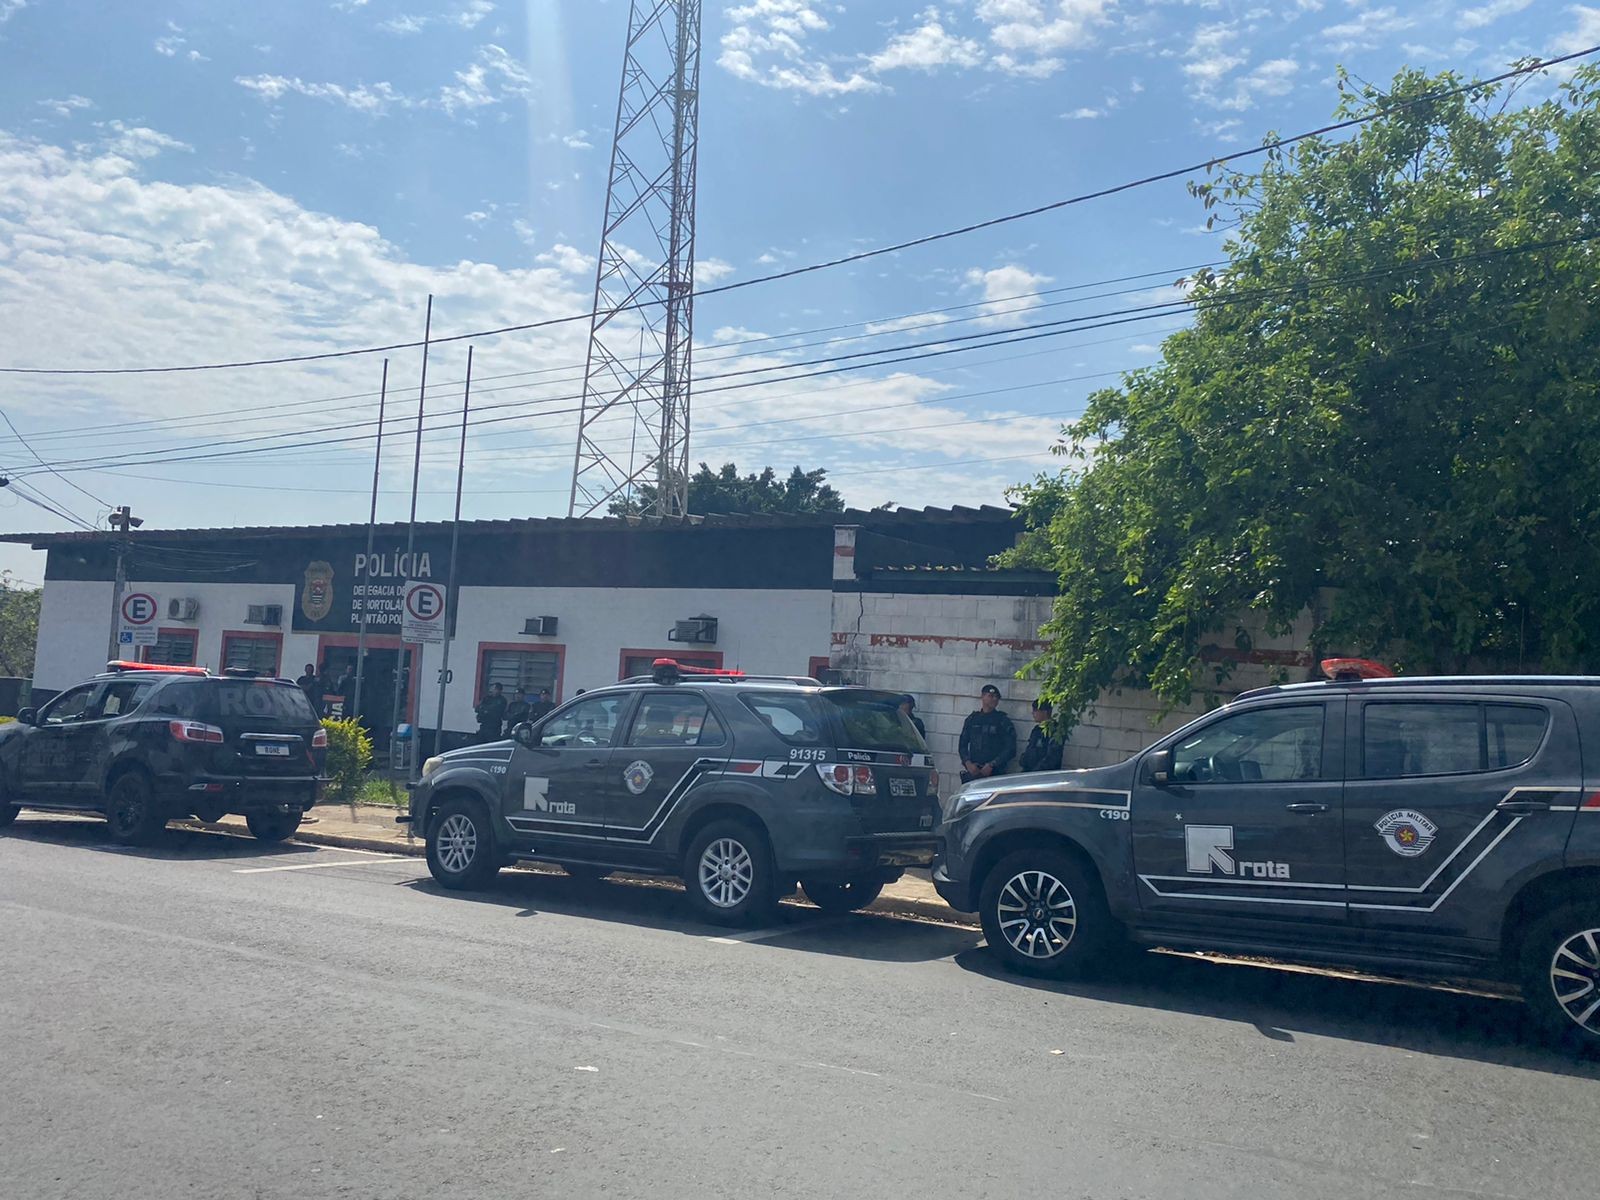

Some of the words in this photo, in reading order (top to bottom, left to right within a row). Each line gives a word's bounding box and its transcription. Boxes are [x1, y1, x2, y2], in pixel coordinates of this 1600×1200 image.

[354, 547, 431, 577] POLÍCIA
[353, 585, 395, 596] DELEGACIA
[132, 599, 147, 619] E
[352, 599, 363, 610] DE
[418, 591, 433, 614] E
[351, 611, 388, 624] PLNTÃO
[790, 748, 826, 761] 91315
[549, 801, 576, 815] rota
[1406, 812, 1433, 832] MILITAR
[1239, 860, 1290, 879] rota
